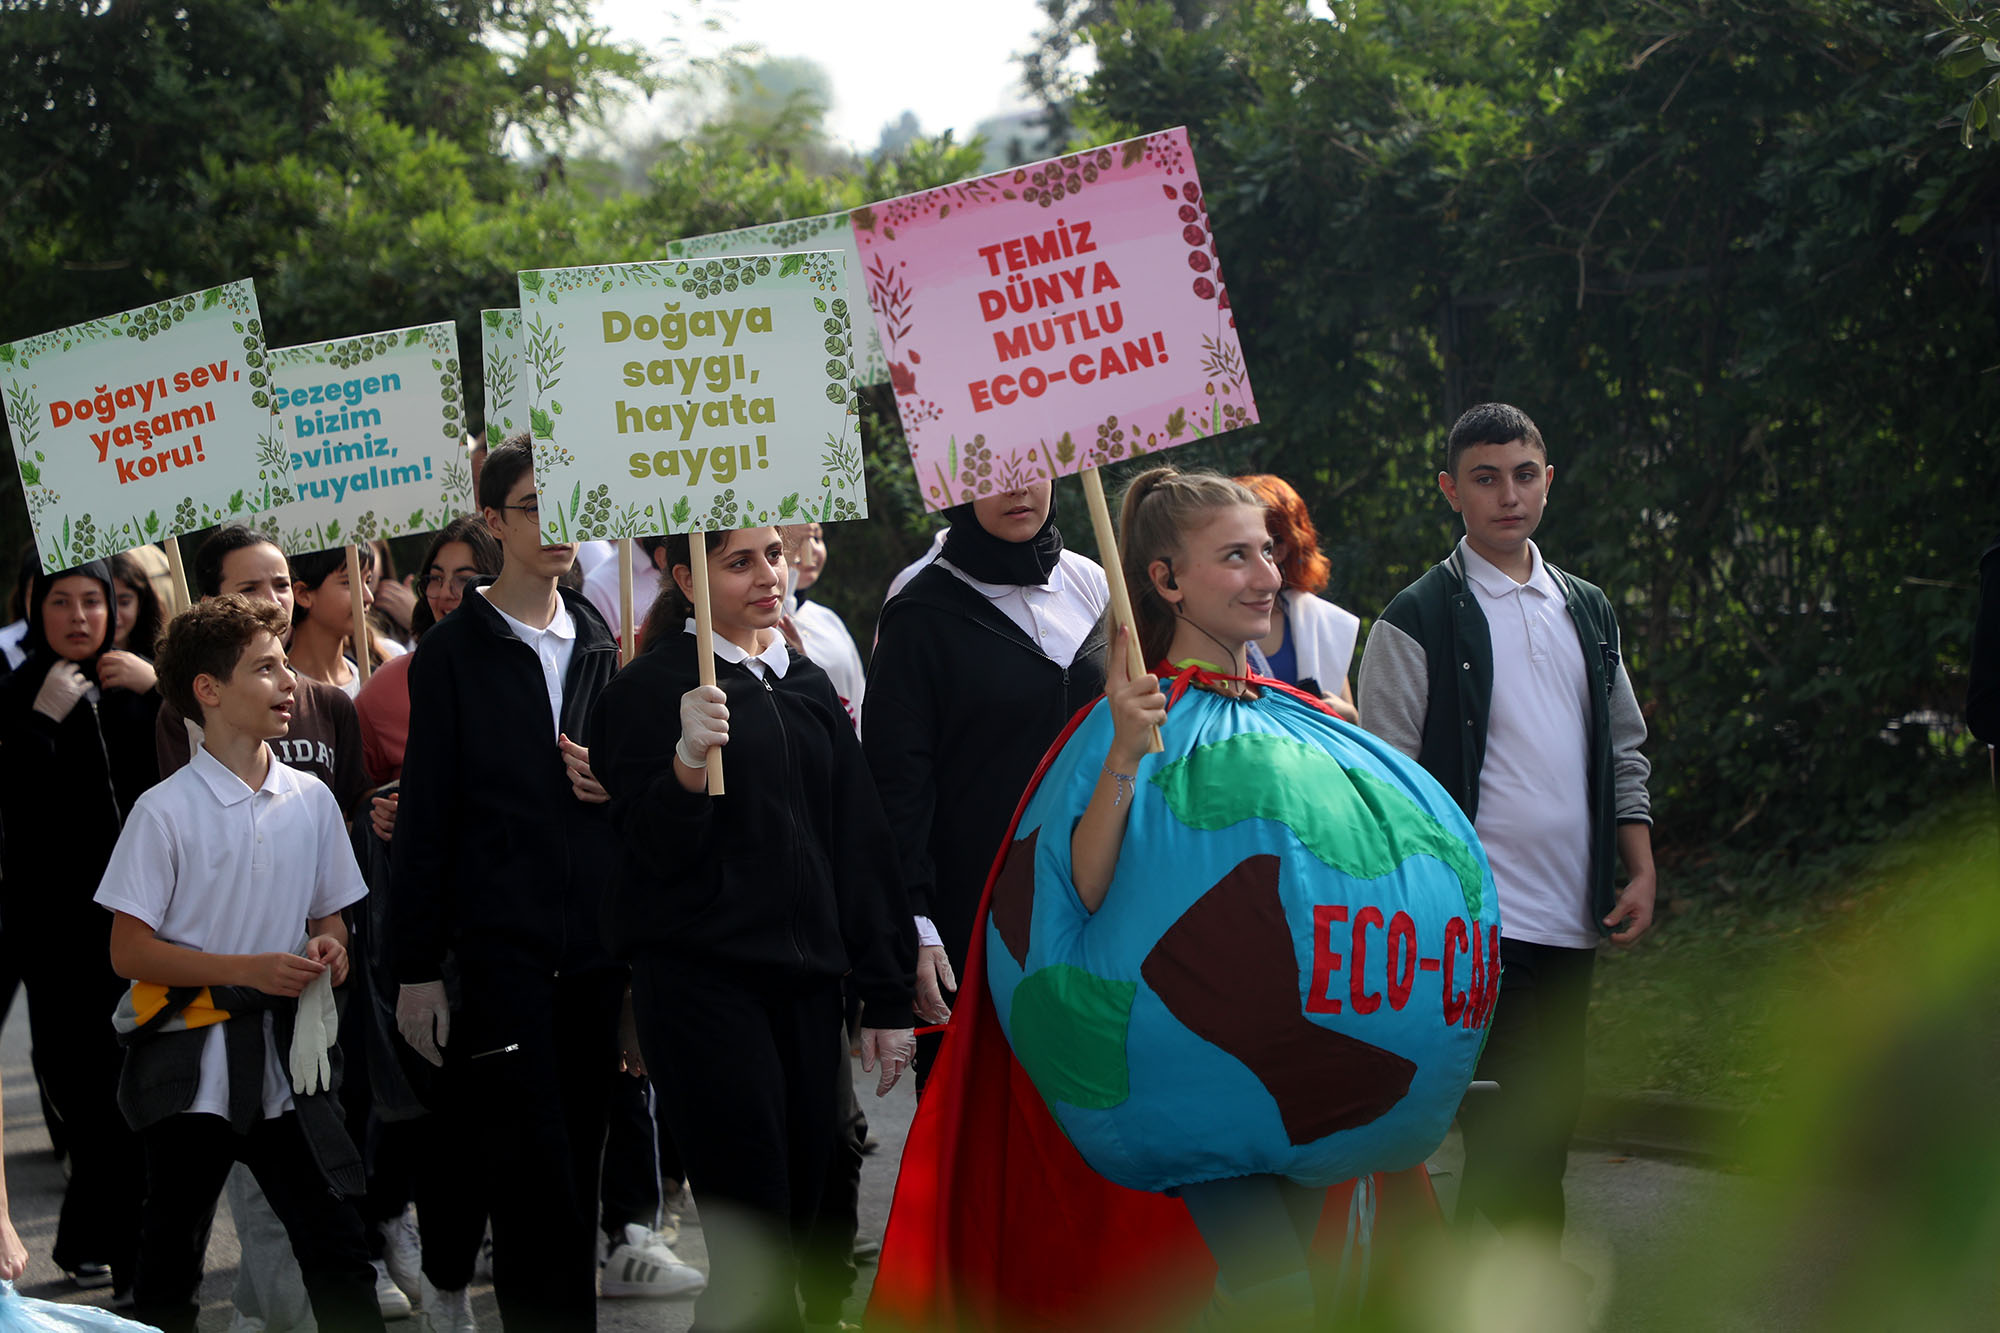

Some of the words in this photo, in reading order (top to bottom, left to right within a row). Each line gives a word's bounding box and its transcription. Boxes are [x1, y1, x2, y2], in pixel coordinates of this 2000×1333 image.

[978, 218, 1097, 277] TEMİZ
[978, 261, 1121, 322] DÜNYA
[602, 301, 774, 351] Doğaya
[993, 301, 1125, 362] MUTLU
[49, 377, 168, 428] Doğayı
[173, 359, 241, 393] sev,
[274, 372, 402, 410] Gezegen
[622, 354, 760, 395] saygı,
[968, 331, 1170, 413] ECO-CAN!
[90, 401, 216, 463] yaşamı
[295, 405, 382, 439] bizim
[615, 394, 776, 441] hayata
[115, 435, 207, 484] koru!
[290, 432, 398, 471] evimiz,
[628, 435, 770, 487] saygı!
[296, 456, 433, 504] ruyalım!
